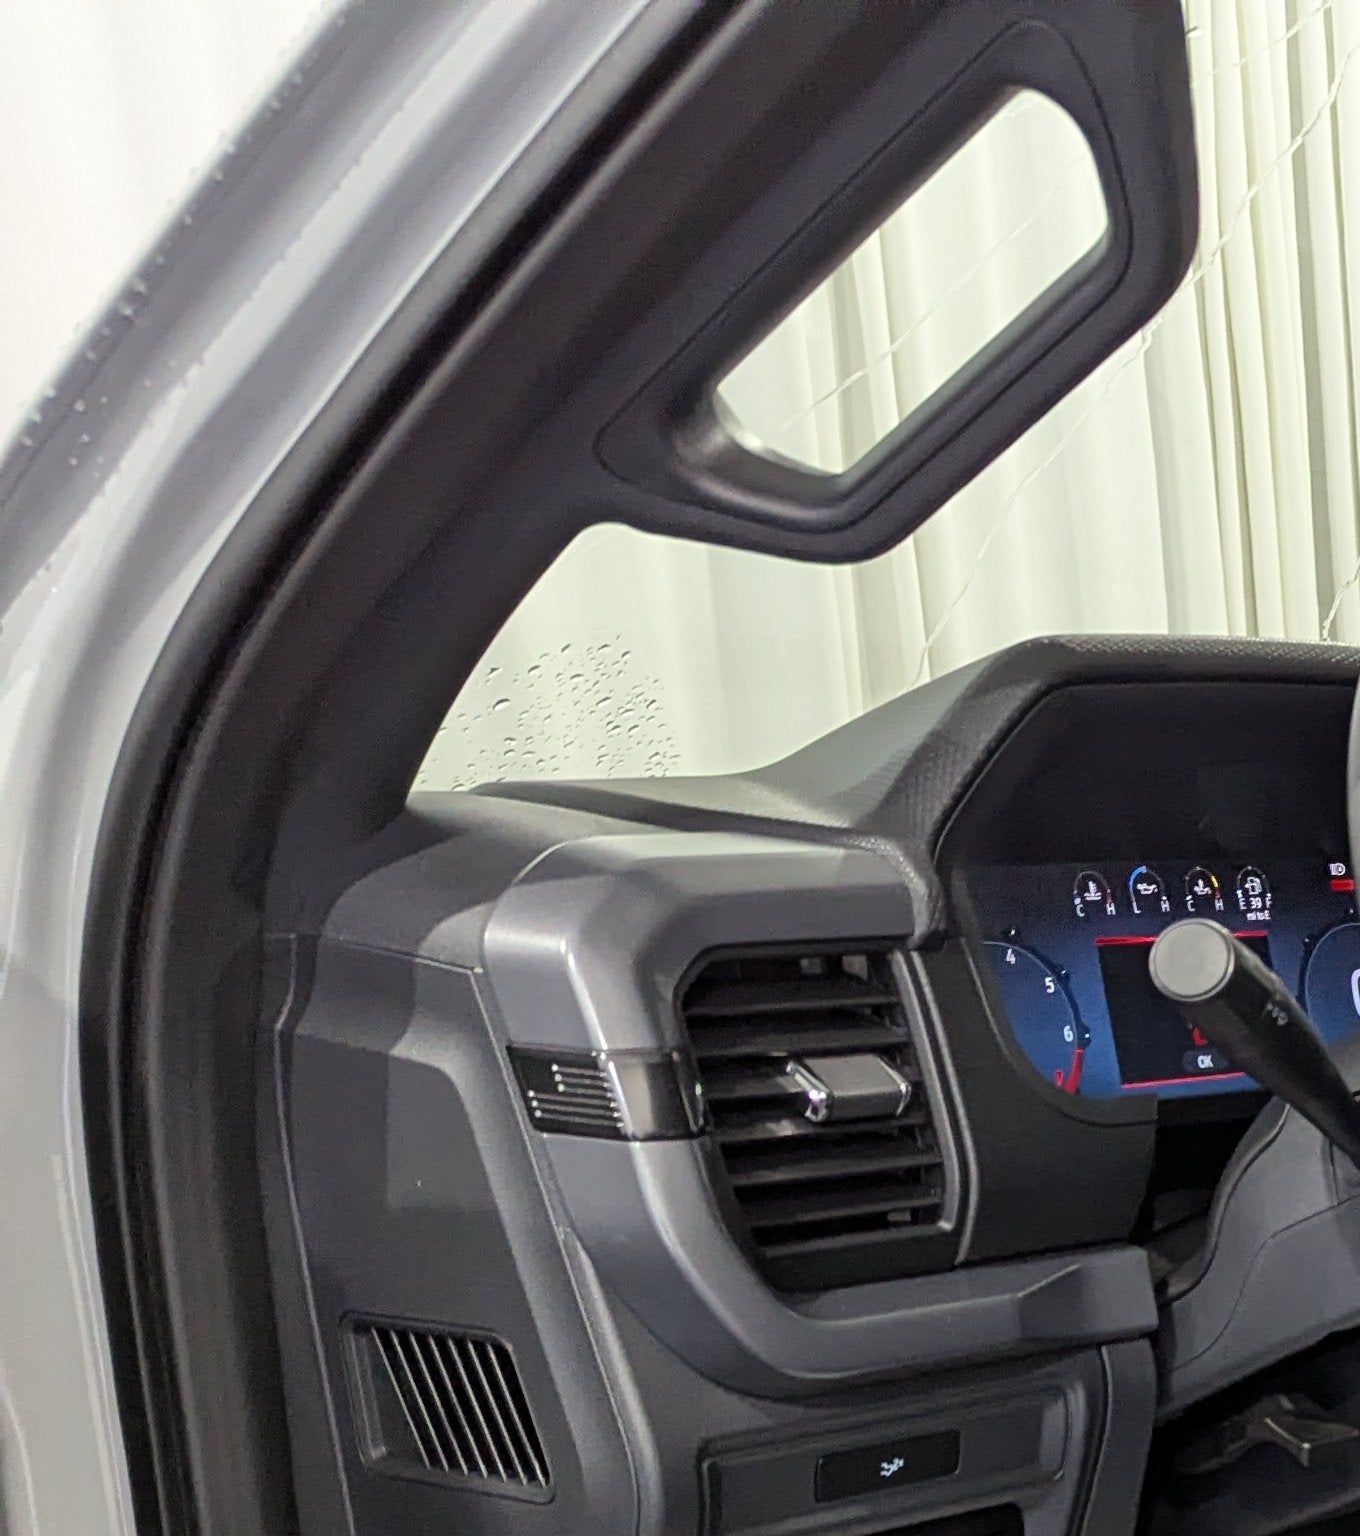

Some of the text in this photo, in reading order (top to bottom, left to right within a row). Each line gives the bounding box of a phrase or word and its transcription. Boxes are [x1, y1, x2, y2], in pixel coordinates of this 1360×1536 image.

[1005, 948, 1017, 965] 4
[1044, 976, 1055, 994] 5
[1063, 1025, 1074, 1043] 6
